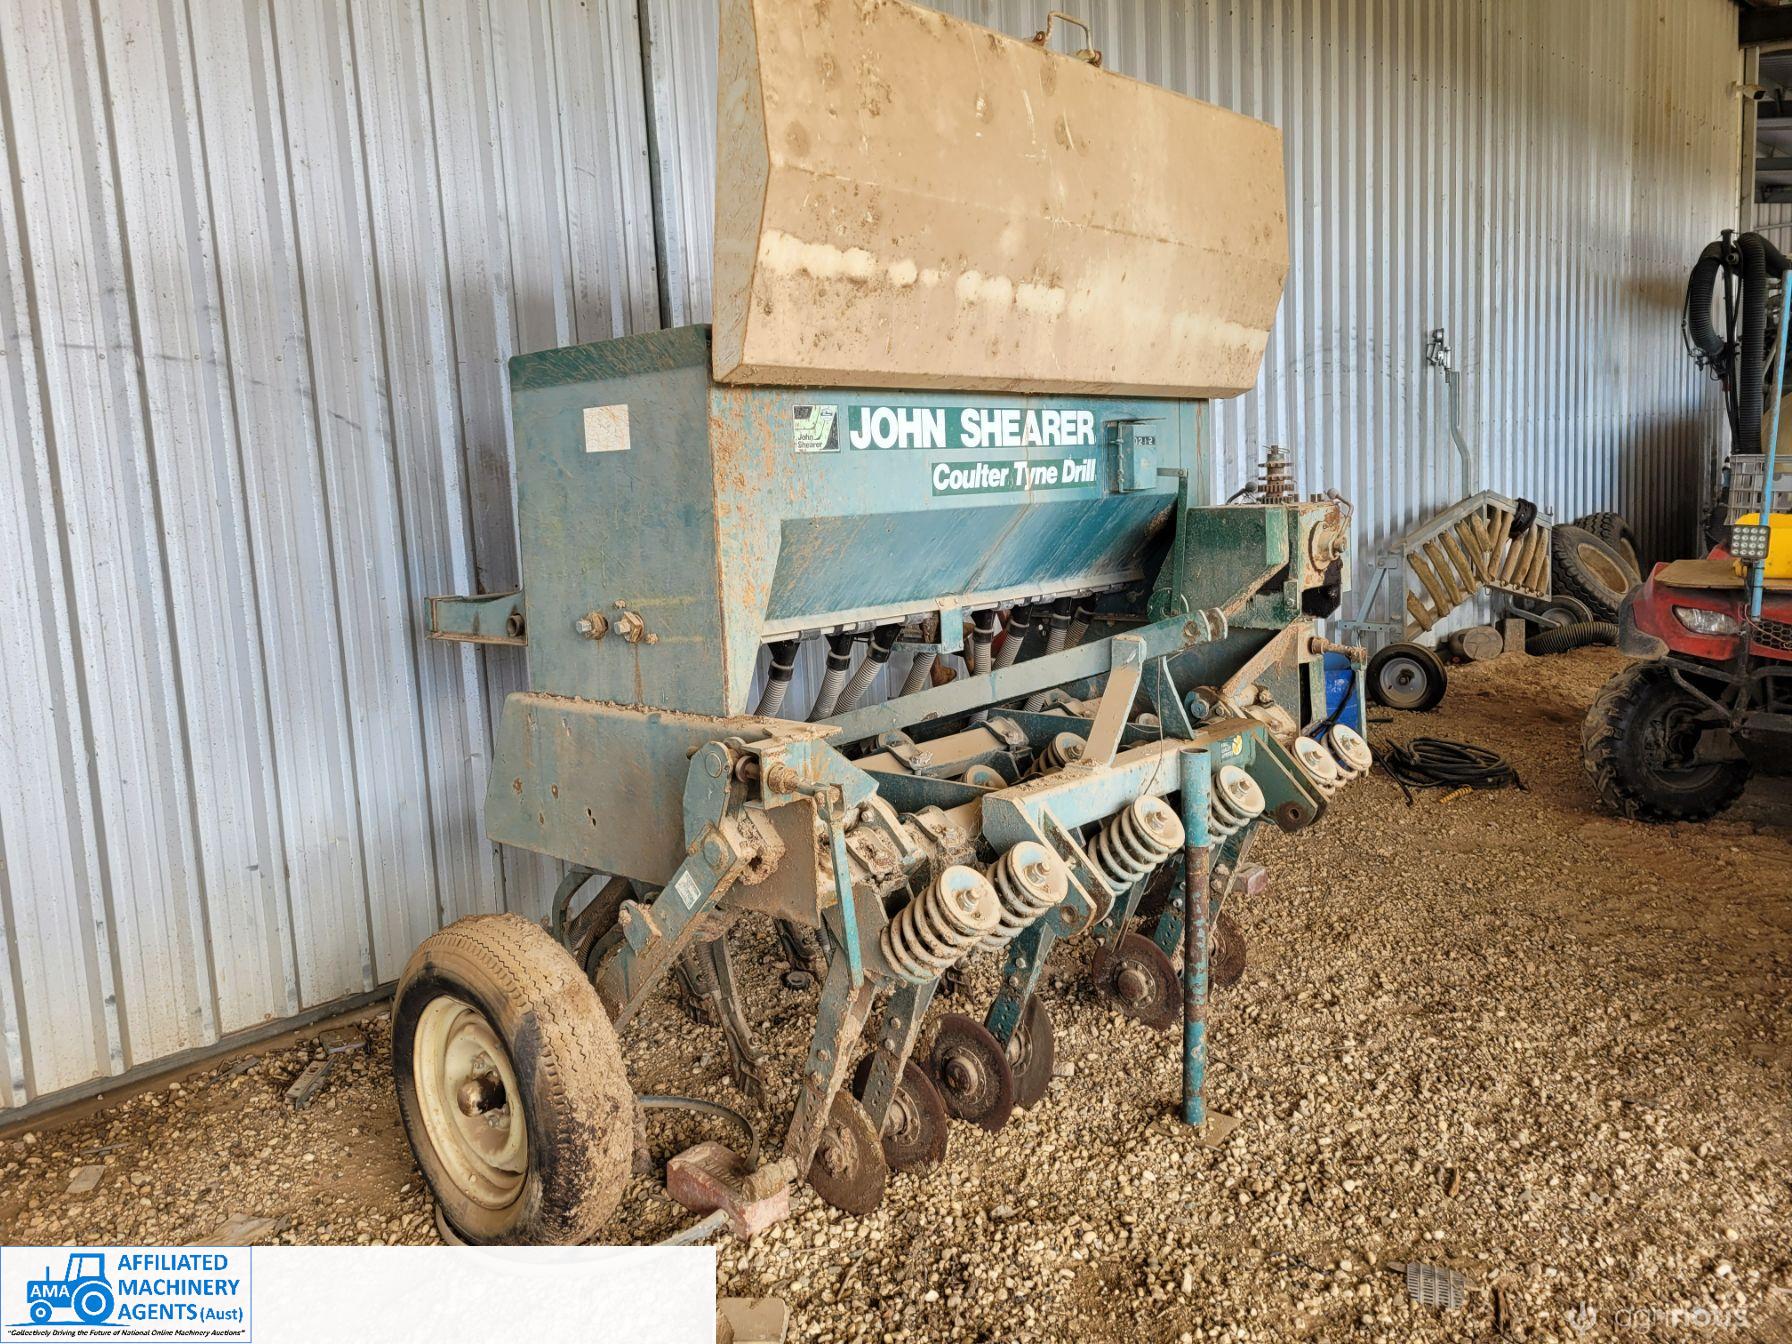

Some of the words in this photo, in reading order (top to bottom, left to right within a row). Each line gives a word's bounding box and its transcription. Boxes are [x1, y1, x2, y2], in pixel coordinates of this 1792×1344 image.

[797, 433, 814, 441] John
[849, 407, 947, 450] JOHN
[960, 408, 1095, 447] SHEARER
[933, 463, 1009, 491] Coulter
[1013, 461, 1058, 491] Tyne
[1062, 459, 1096, 484] Drill
